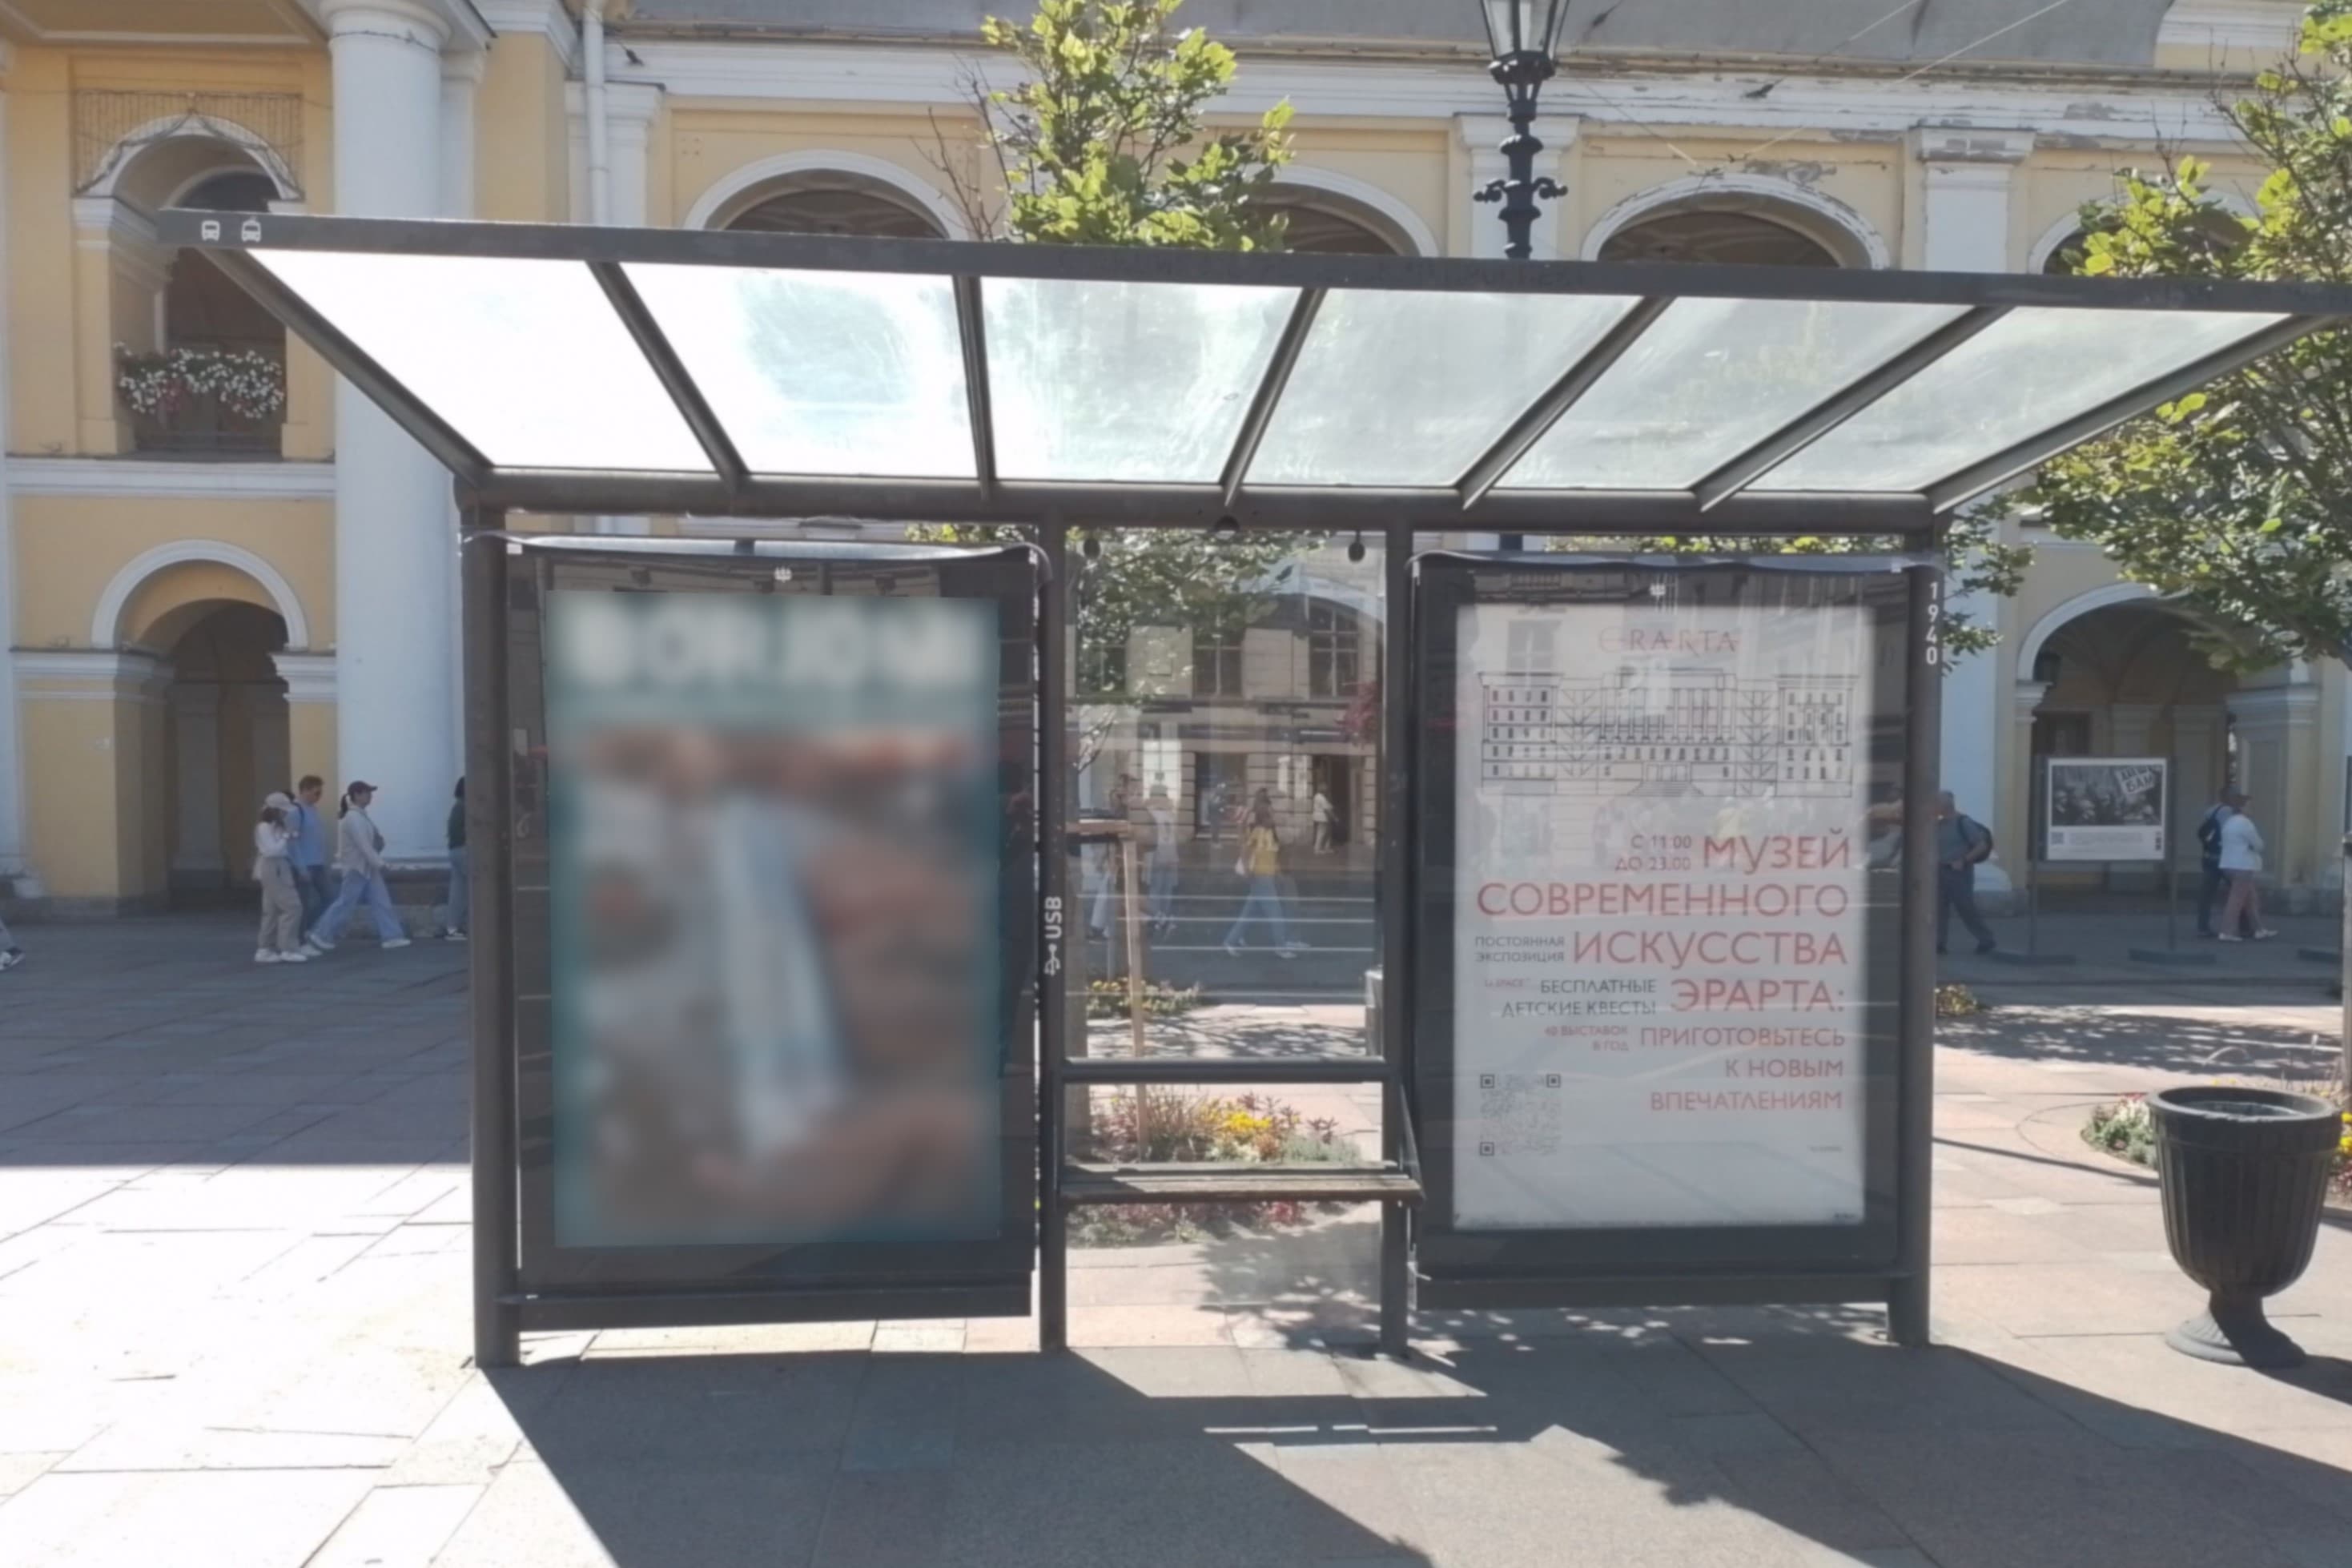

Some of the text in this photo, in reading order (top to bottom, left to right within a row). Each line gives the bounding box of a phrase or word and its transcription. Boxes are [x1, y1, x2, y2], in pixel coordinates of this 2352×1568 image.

[1926, 582, 1938, 665] 1940
[1703, 828, 1849, 874] МУЗЕЙ
[1614, 856, 1642, 871] ДО
[1477, 883, 1848, 917] СОВРЕМЕННОГО
[1044, 896, 1062, 939] USB
[1475, 935, 1565, 948] ПОСТОЯННАЯ
[1574, 931, 1848, 970] ИСКУССТВА
[1475, 951, 1565, 963] ЭКСПОЗИЦИЯ
[1541, 979, 1657, 994] БЕСПЛАТНЫЕ
[1671, 979, 1844, 1012] ЭРАРТА:
[1502, 1001, 1656, 1018] ДЕТСКИЕ КВЕСТЫ
[1561, 1026, 1628, 1036] ВЫСТАВОК
[1641, 1028, 1845, 1047] ПРИГОТОВЬТЕСЬ
[1604, 1040, 1629, 1051] ГОД
[1725, 1059, 1843, 1078] К НОВЫМ
[1650, 1092, 1842, 1111] ВПЕЧАТЛЕНИЯМ
